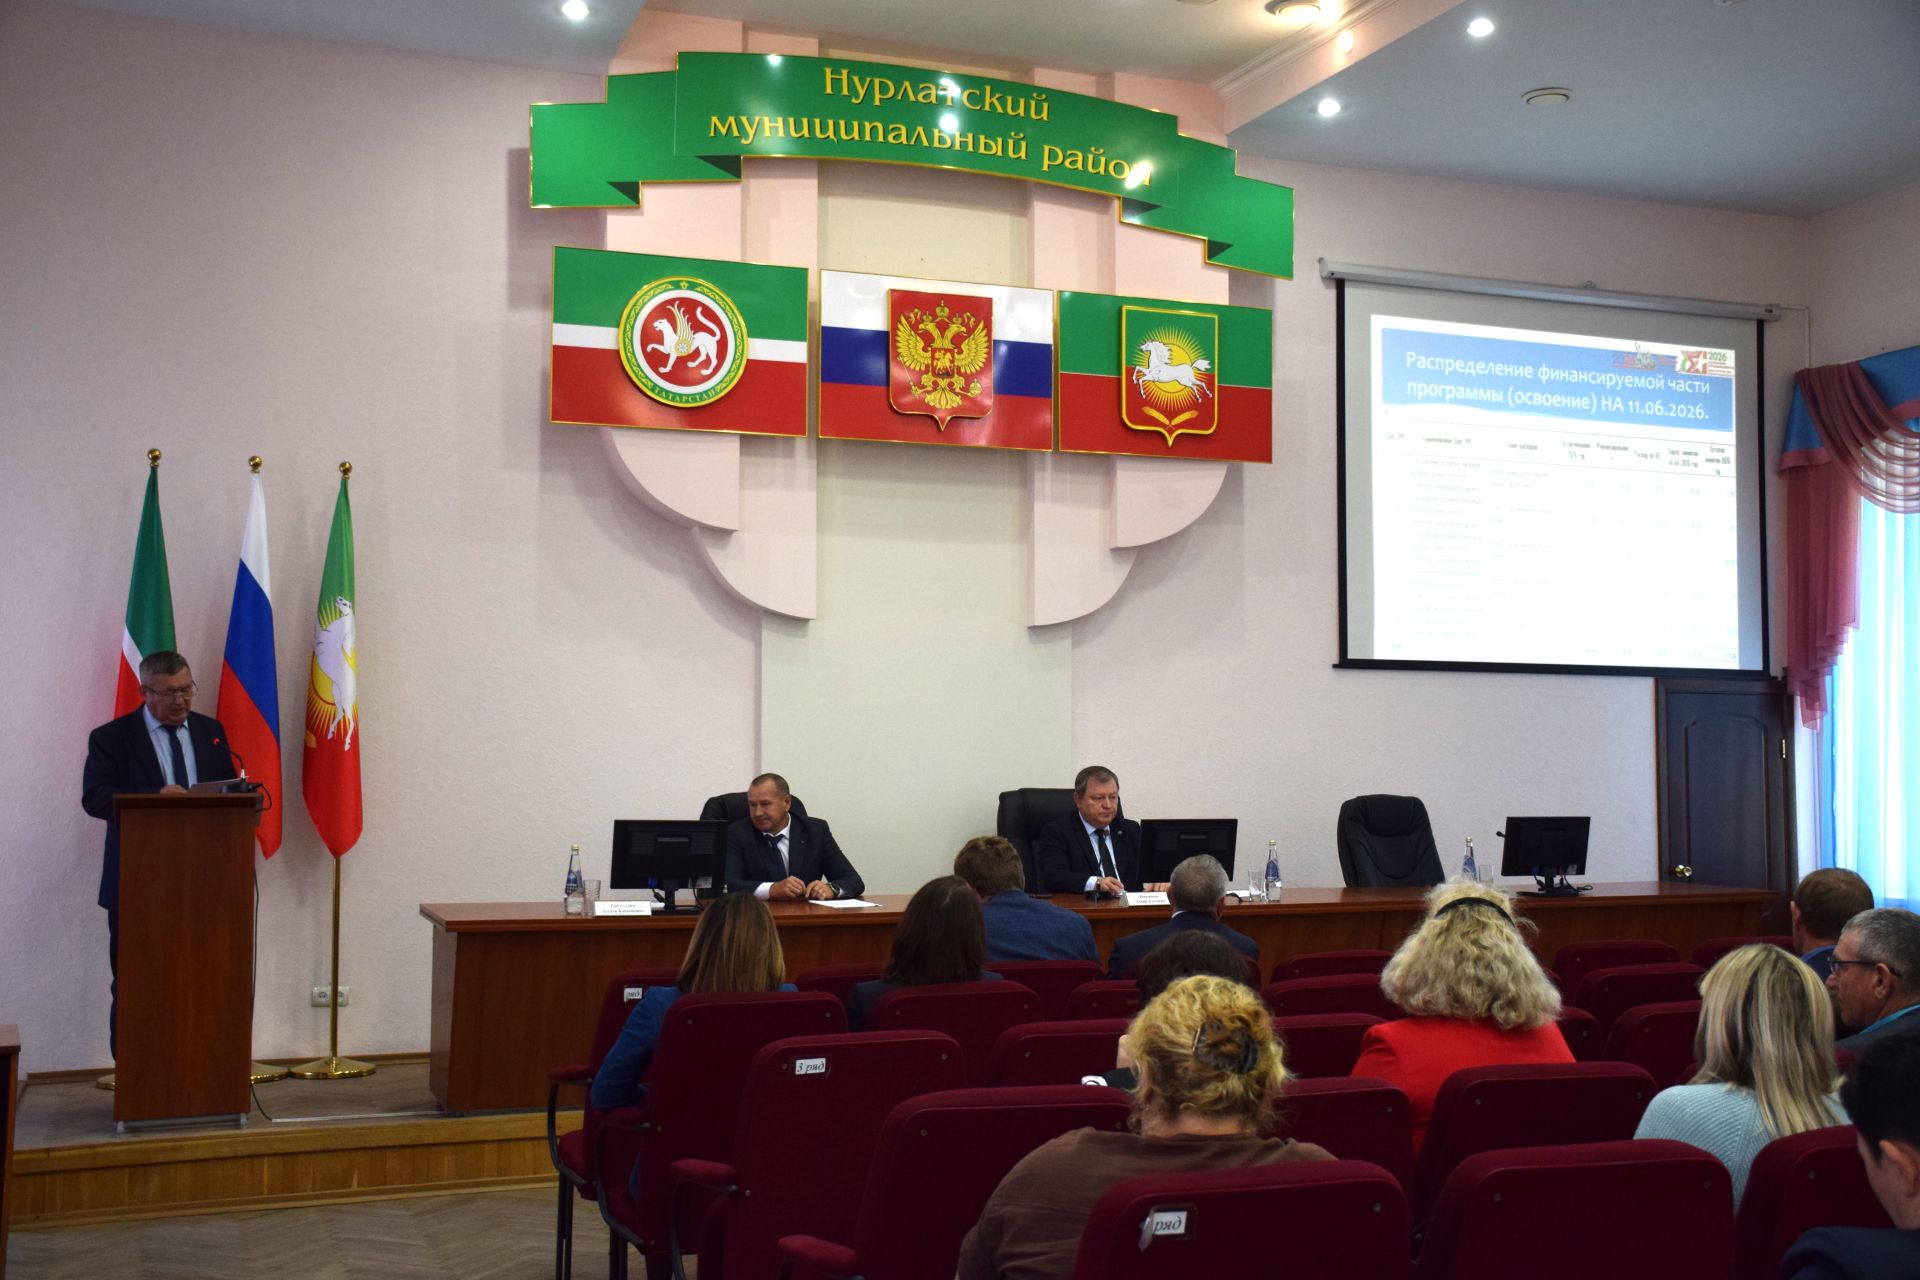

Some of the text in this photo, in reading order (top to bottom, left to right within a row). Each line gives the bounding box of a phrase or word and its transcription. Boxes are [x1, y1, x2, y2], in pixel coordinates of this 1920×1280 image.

[824, 67, 1049, 121] Нурлатский
[709, 115, 1027, 160] муниципальный
[1406, 351, 1710, 394] Распределение финансируемой части
[1407, 381, 1709, 420] программы (освоение) НА 11.06.2026.
[797, 1060, 825, 1074] 3 ряд
[1153, 1215, 1182, 1234] ряд
